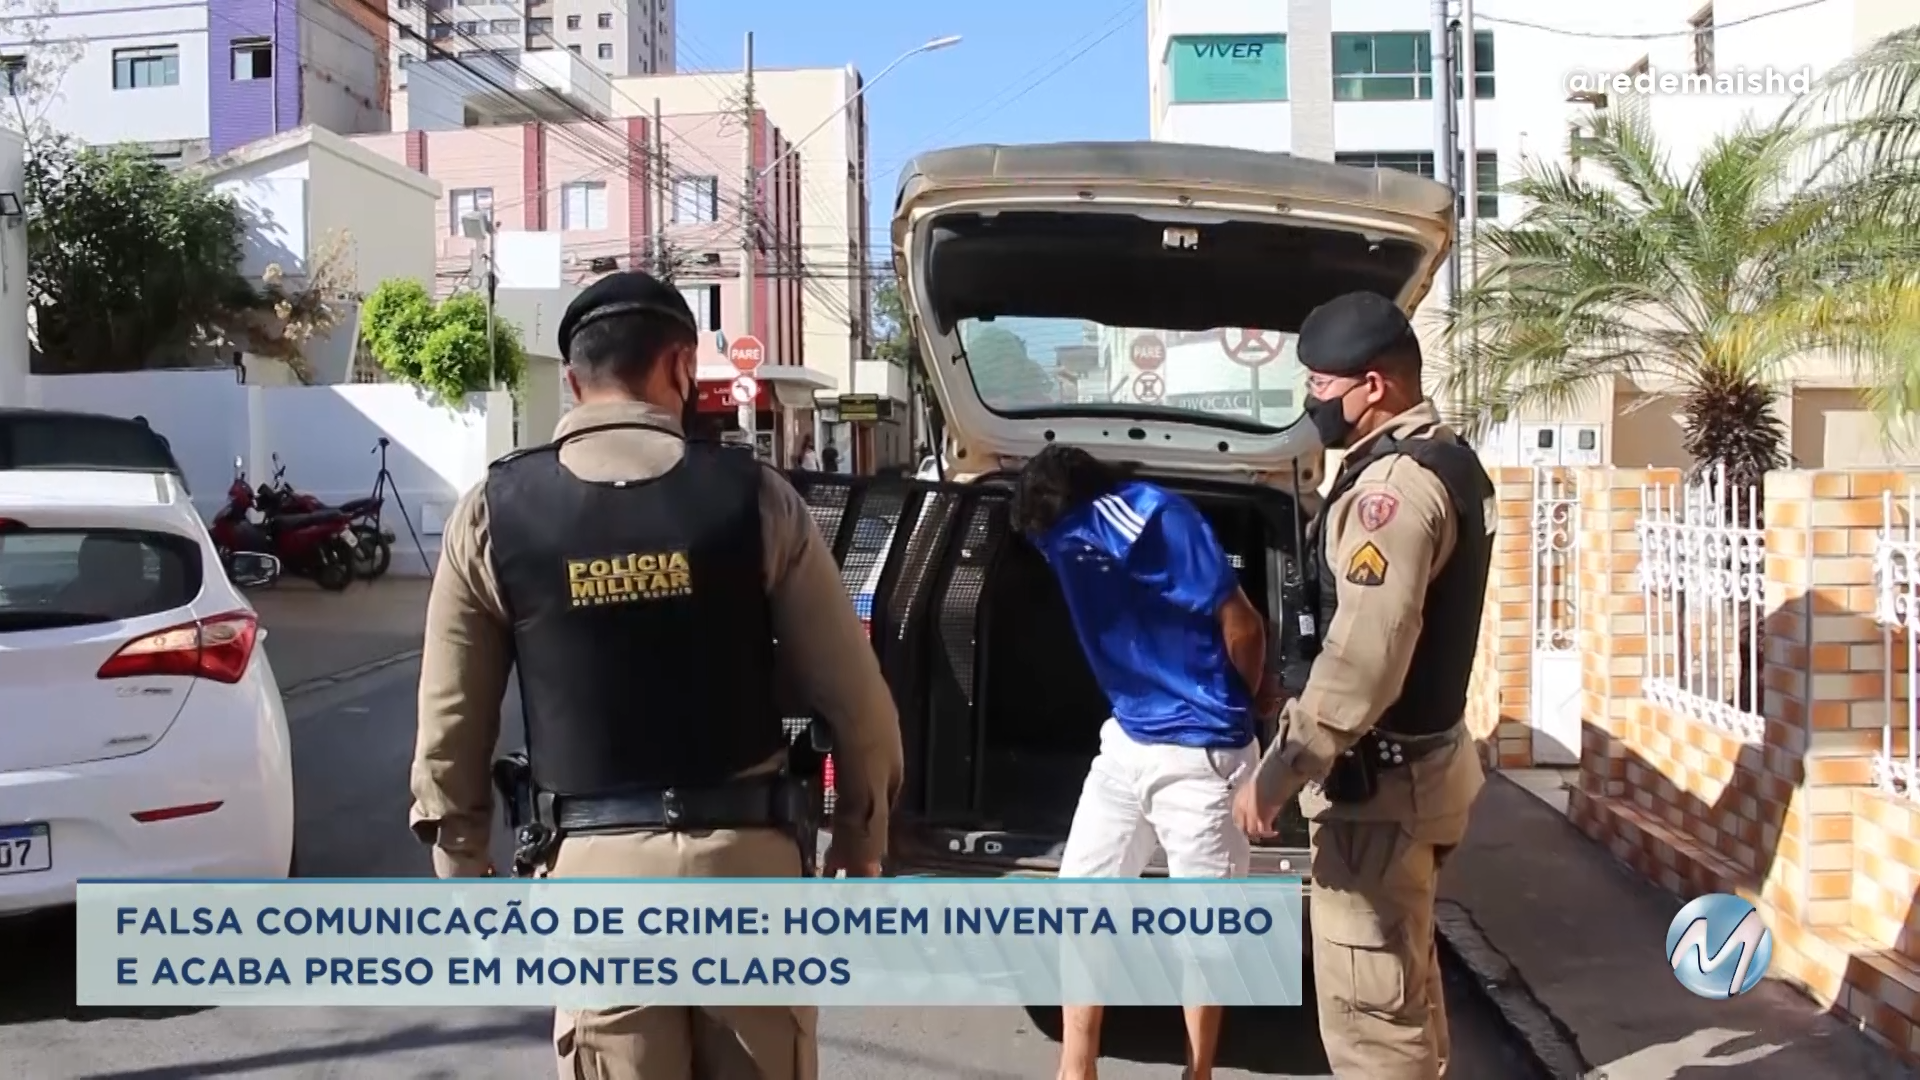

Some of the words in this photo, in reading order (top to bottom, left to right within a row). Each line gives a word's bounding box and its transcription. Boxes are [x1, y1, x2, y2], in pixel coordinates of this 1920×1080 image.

[1193, 42, 1264, 58] VIVER
[732, 348, 760, 360] PARE
[1133, 345, 1163, 359] PARE
[571, 572, 691, 598] MILITAR
